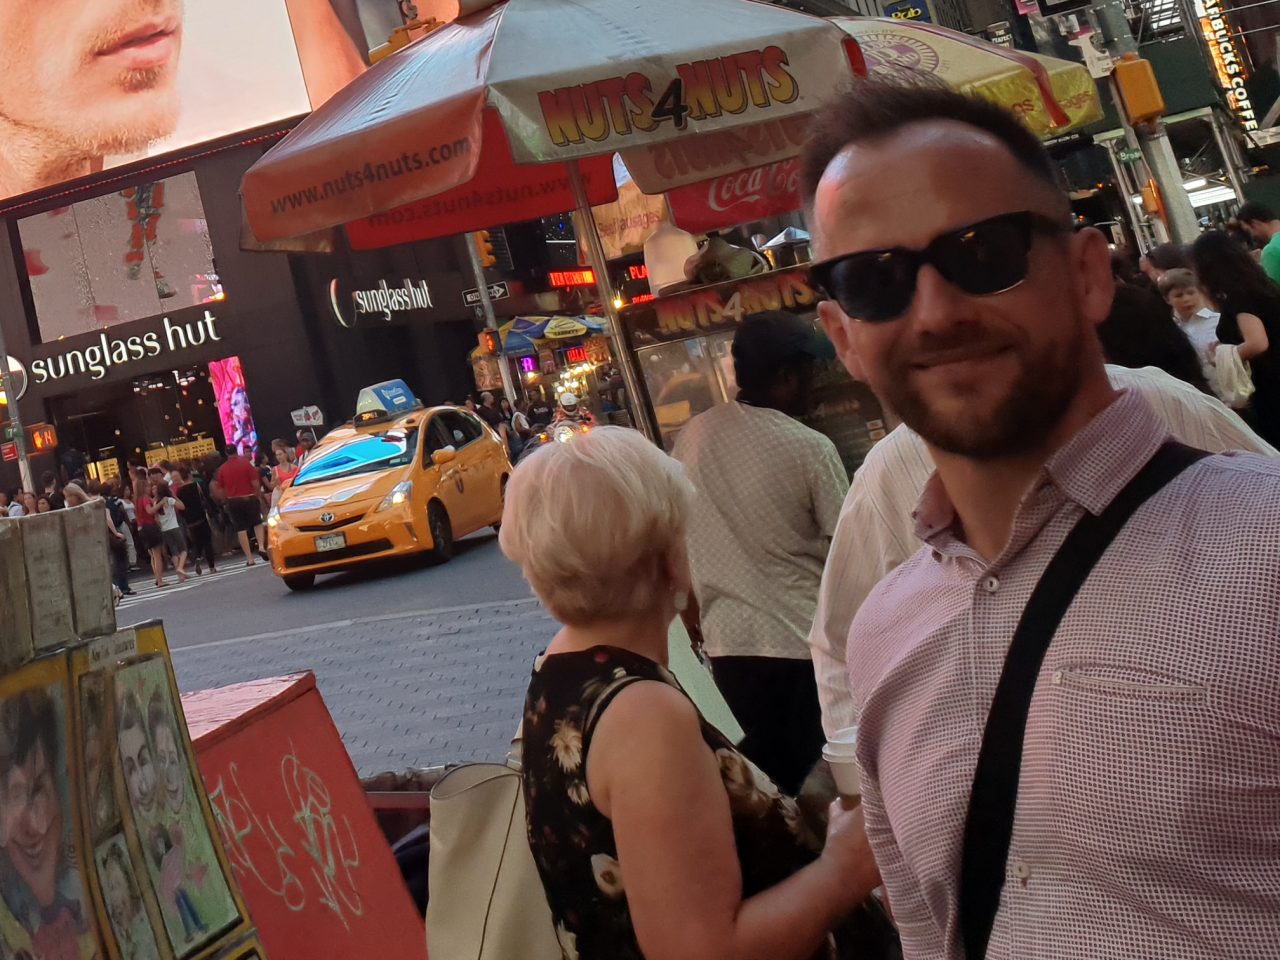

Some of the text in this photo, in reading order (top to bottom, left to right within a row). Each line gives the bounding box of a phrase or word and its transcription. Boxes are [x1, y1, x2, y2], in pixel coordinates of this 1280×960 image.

[1231, 76, 1259, 132] COFFE
[270, 136, 472, 215] www.nuts4nuts.com
[355, 278, 434, 321] sunglass hut
[31, 309, 223, 384] sunglass hut
